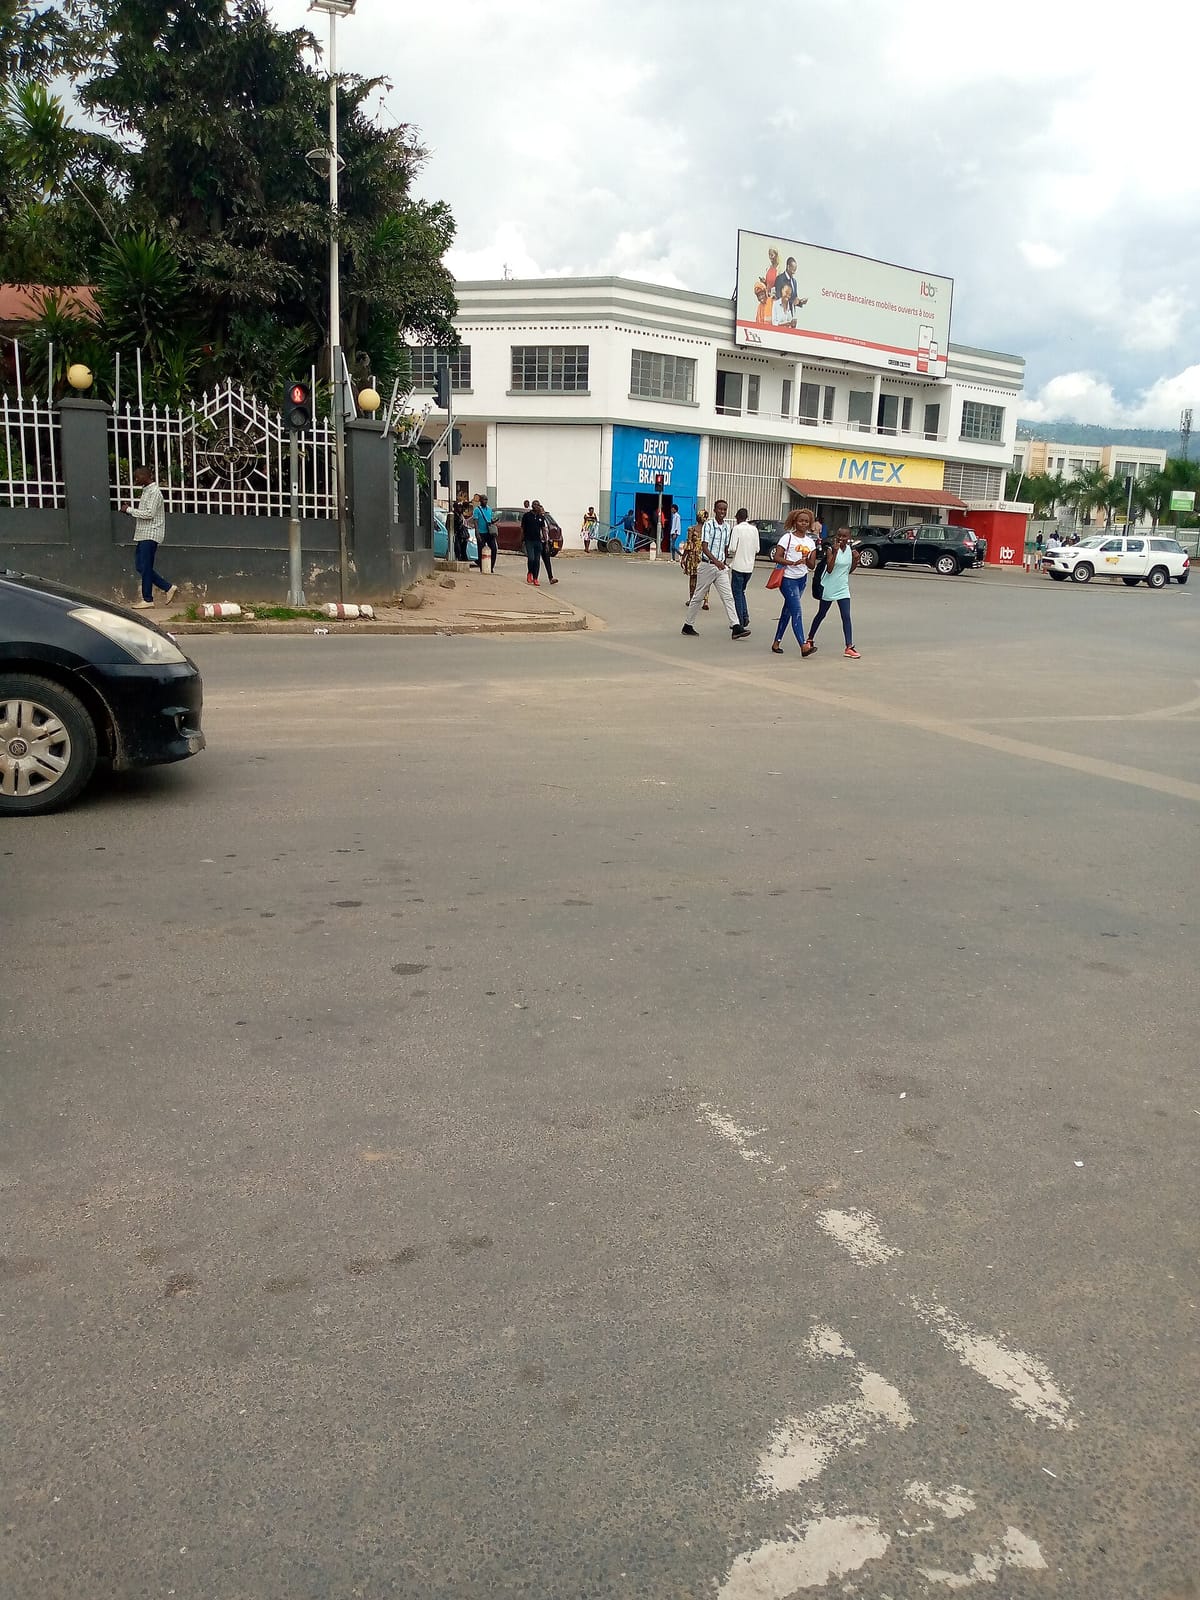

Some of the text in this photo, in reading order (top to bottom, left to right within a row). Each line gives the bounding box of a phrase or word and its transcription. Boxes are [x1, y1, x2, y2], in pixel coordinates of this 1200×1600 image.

[821, 288, 846, 300] Services
[847, 292, 875, 307] Bancaires
[876, 301, 897, 312] mobiles
[898, 307, 918, 316] ouverts
[923, 310, 935, 319] tous
[643, 438, 669, 455] DEPOT
[637, 453, 674, 471] PRODUITS
[838, 458, 905, 484] IMEX
[639, 469, 671, 486] BRADI
